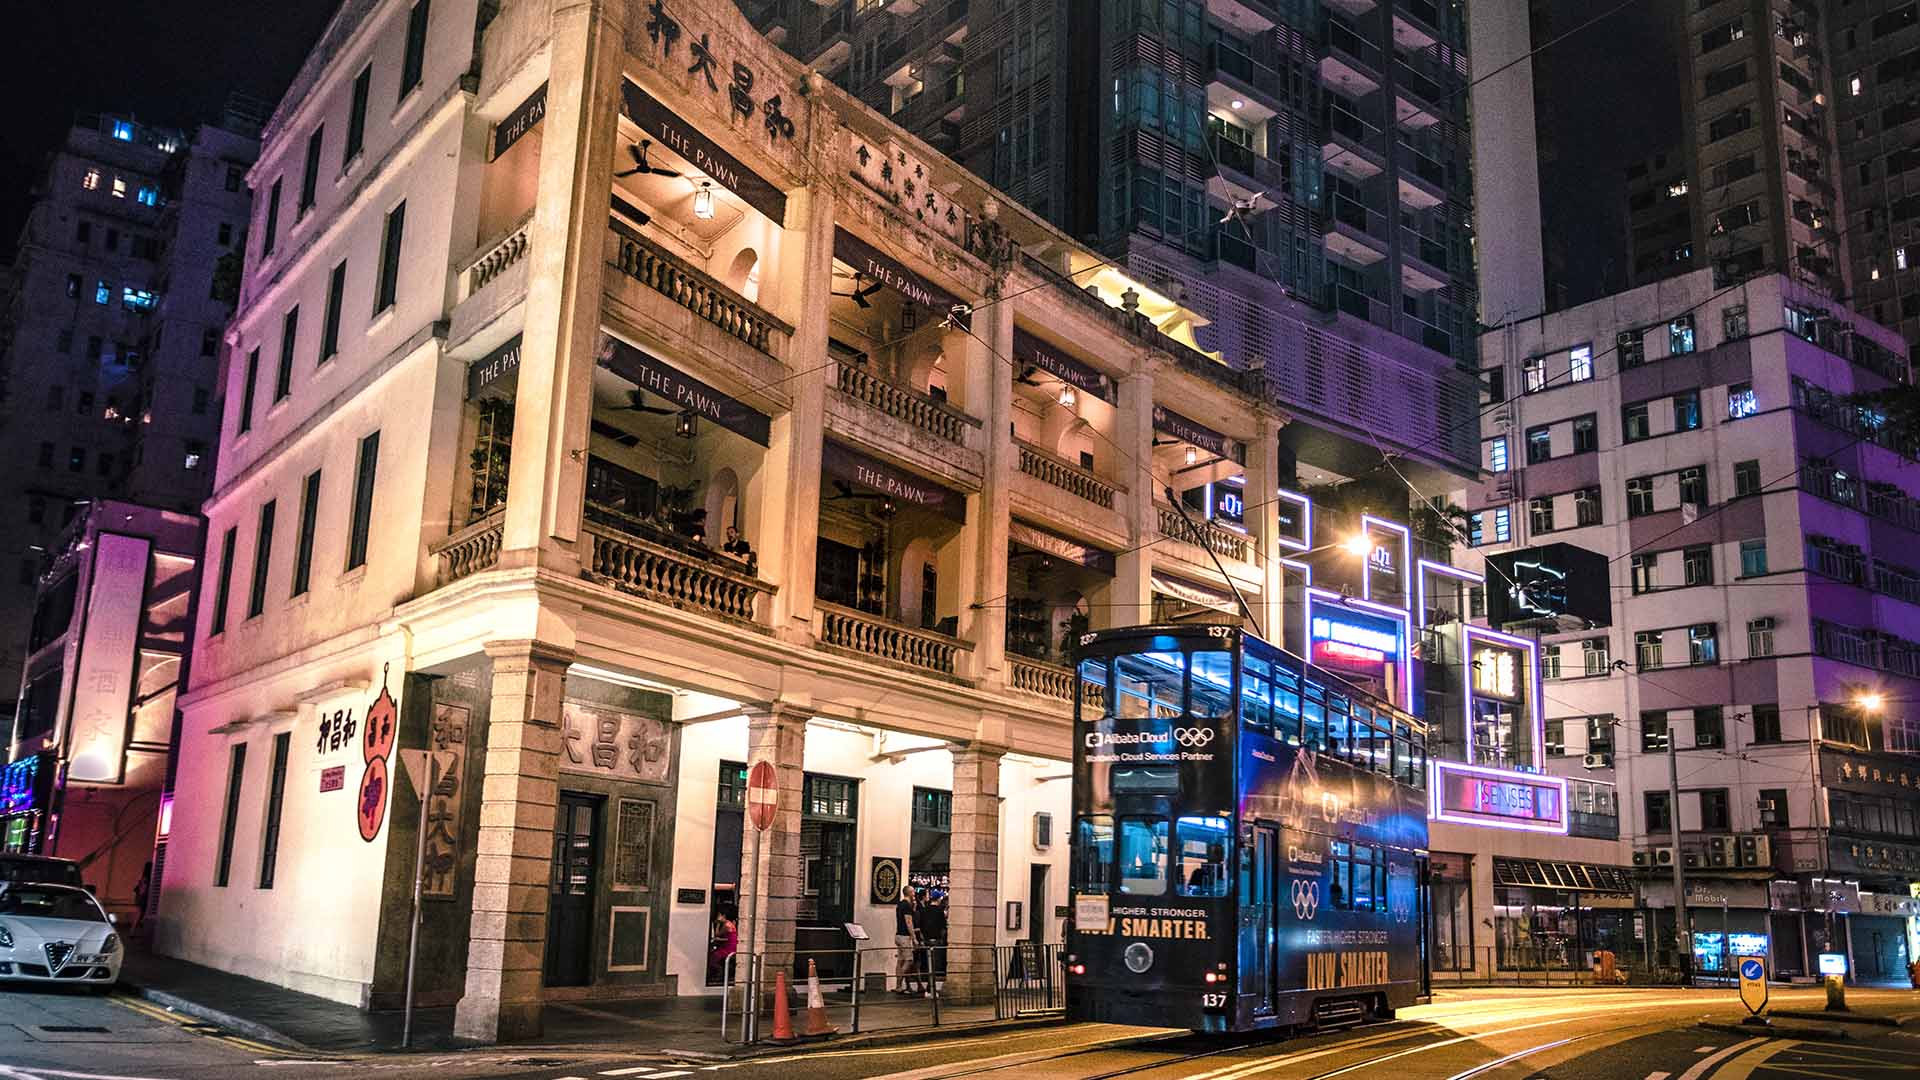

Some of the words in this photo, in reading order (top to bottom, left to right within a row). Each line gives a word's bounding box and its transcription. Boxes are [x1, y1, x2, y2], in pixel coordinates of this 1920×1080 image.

[506, 114, 526, 144] THE
[530, 96, 547, 123] PA
[661, 122, 690, 156] THE
[696, 149, 738, 190] PAWN
[867, 258, 892, 285] THE
[896, 276, 932, 305] PAWN
[480, 360, 499, 386] THE
[503, 346, 521, 372] PA
[1035, 350, 1056, 370] THE
[1058, 363, 1088, 388] PAWN
[640, 364, 671, 394] THE
[677, 383, 720, 419] PAWN
[1171, 422, 1190, 440] THE
[1191, 431, 1217, 451] PAWN
[857, 465, 883, 488] THE
[887, 478, 925, 505] PAWN
[1207, 626, 1231, 638] 137
[1103, 733, 1140, 744] Alibaba
[1140, 732, 1168, 743] Cloud
[1121, 753, 1143, 761] Cloud
[1144, 752, 1180, 761] Services
[1181, 751, 1214, 761] Partner
[1481, 783, 1532, 810] SENSES
[1113, 907, 1149, 916] HIGHER.
[1151, 908, 1208, 918] STRONGER.
[1121, 917, 1212, 940] SMARTER.
[1307, 953, 1337, 990] NOW
[1202, 993, 1227, 1007] 137
